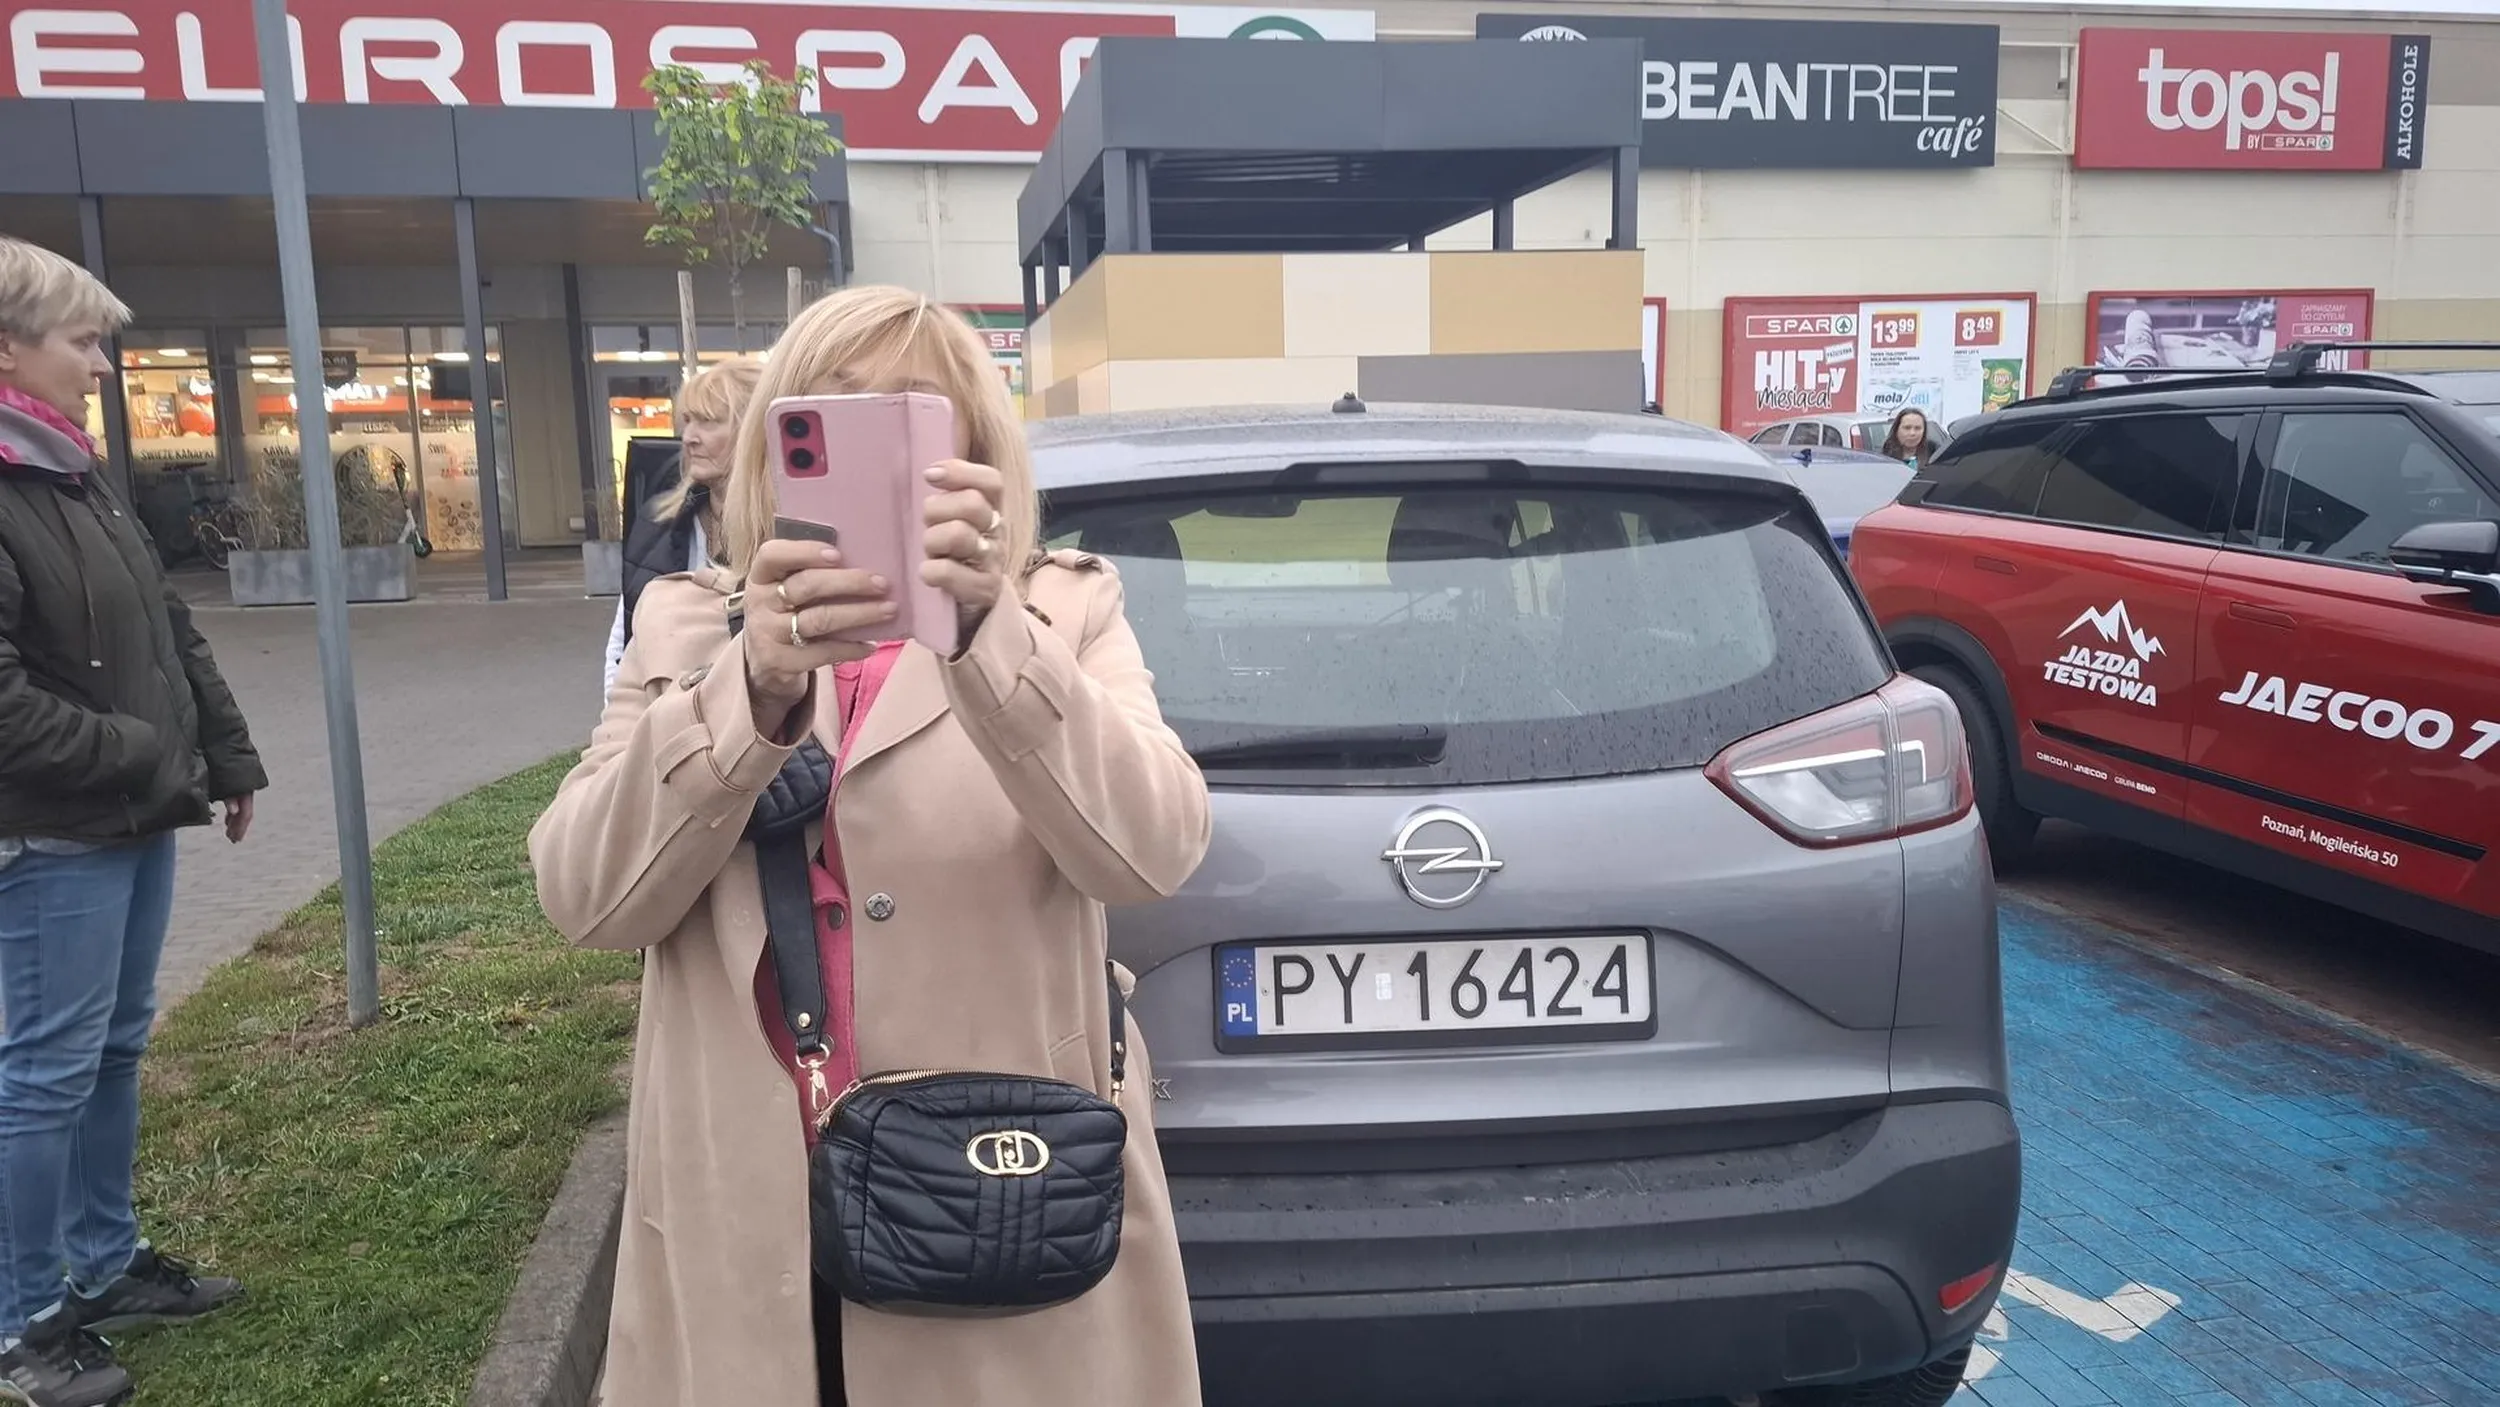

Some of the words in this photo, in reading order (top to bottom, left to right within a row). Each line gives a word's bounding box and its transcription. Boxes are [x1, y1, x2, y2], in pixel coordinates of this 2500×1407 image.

[1642, 60, 1958, 122] BEANTREE
[2138, 47, 2340, 150] tops!
[2396, 44, 2419, 160] ALKOHOLE
[1917, 115, 1983, 158] café
[2247, 134, 2260, 149] BY
[2275, 137, 2316, 148] SPAR
[1767, 319, 1830, 333] SPAR
[2303, 325, 2338, 334] SPAR
[2043, 660, 2158, 708] TESTOWA
[2060, 645, 2141, 679] JAZDA
[2219, 671, 2455, 751] JAECOO
[2459, 719, 2500, 761] 7
[2261, 814, 2308, 842] Poznań,
[2309, 829, 2380, 862] Mogileńska
[2380, 851, 2399, 868] 50
[1272, 951, 1367, 1026] PY
[1404, 942, 1632, 1022] 16424
[1227, 1004, 1252, 1023] PL
